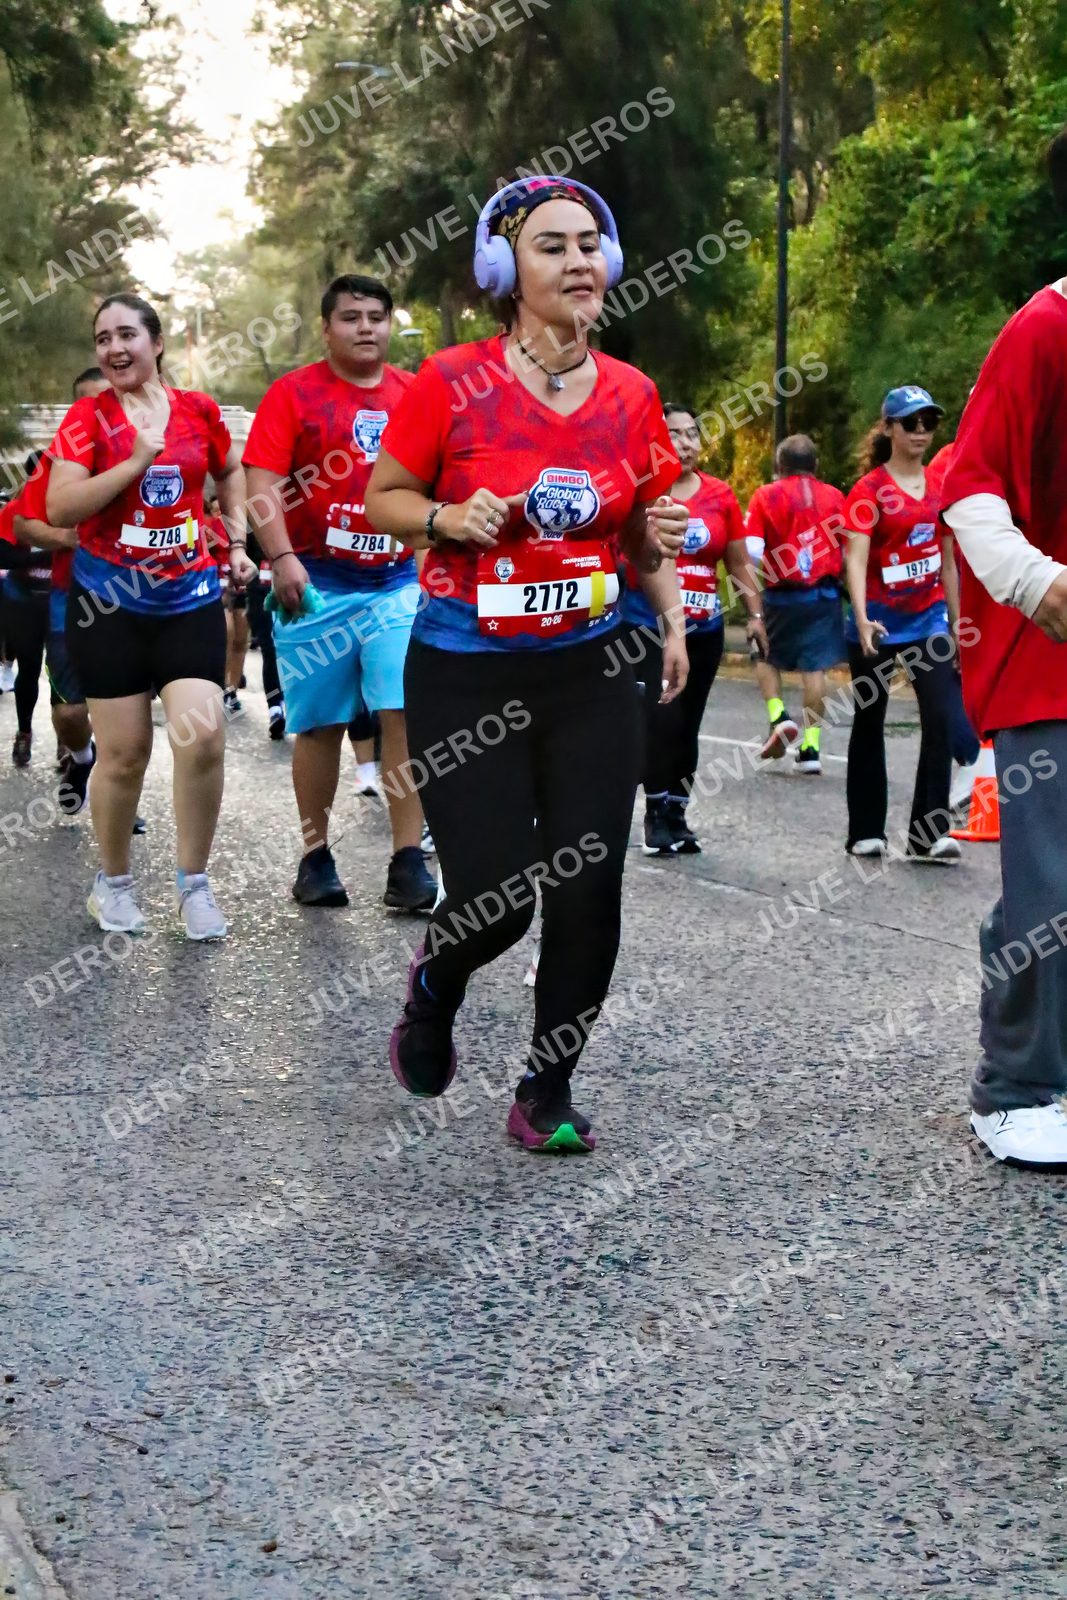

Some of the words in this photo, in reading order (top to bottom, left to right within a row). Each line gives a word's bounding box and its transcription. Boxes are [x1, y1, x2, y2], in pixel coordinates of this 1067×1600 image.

[546, 474, 585, 485] BIMBO
[546, 487, 582, 501] Global
[536, 497, 568, 509] Race
[149, 527, 181, 547] 2748
[351, 534, 385, 551] 2784
[906, 560, 930, 577] 1972
[523, 581, 579, 613] 2772
